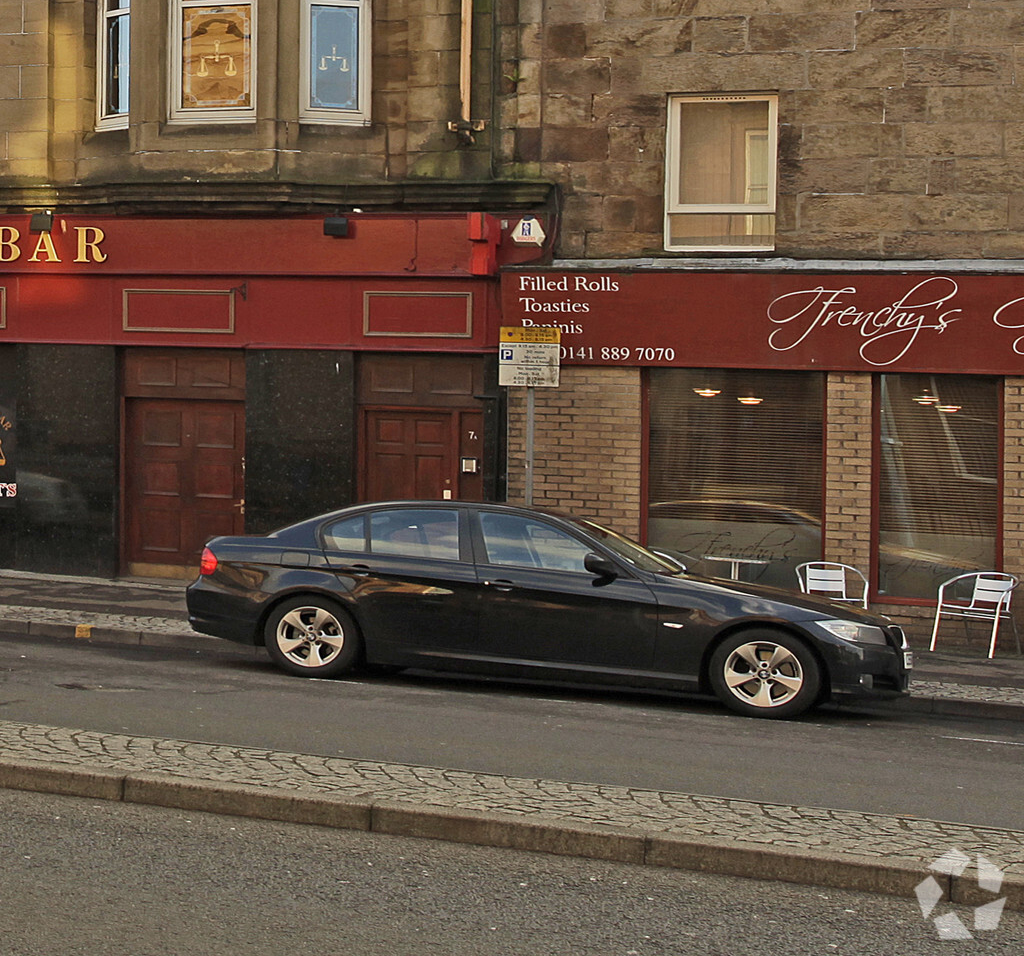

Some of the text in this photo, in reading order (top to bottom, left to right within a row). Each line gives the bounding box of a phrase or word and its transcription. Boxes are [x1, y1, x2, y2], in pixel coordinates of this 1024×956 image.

[519, 276, 620, 292] Filled Rolls
[519, 297, 590, 313] Toasties
[767, 276, 963, 366] Frenchy's
[601, 346, 630, 361] 889
[635, 348, 676, 362] 7070
